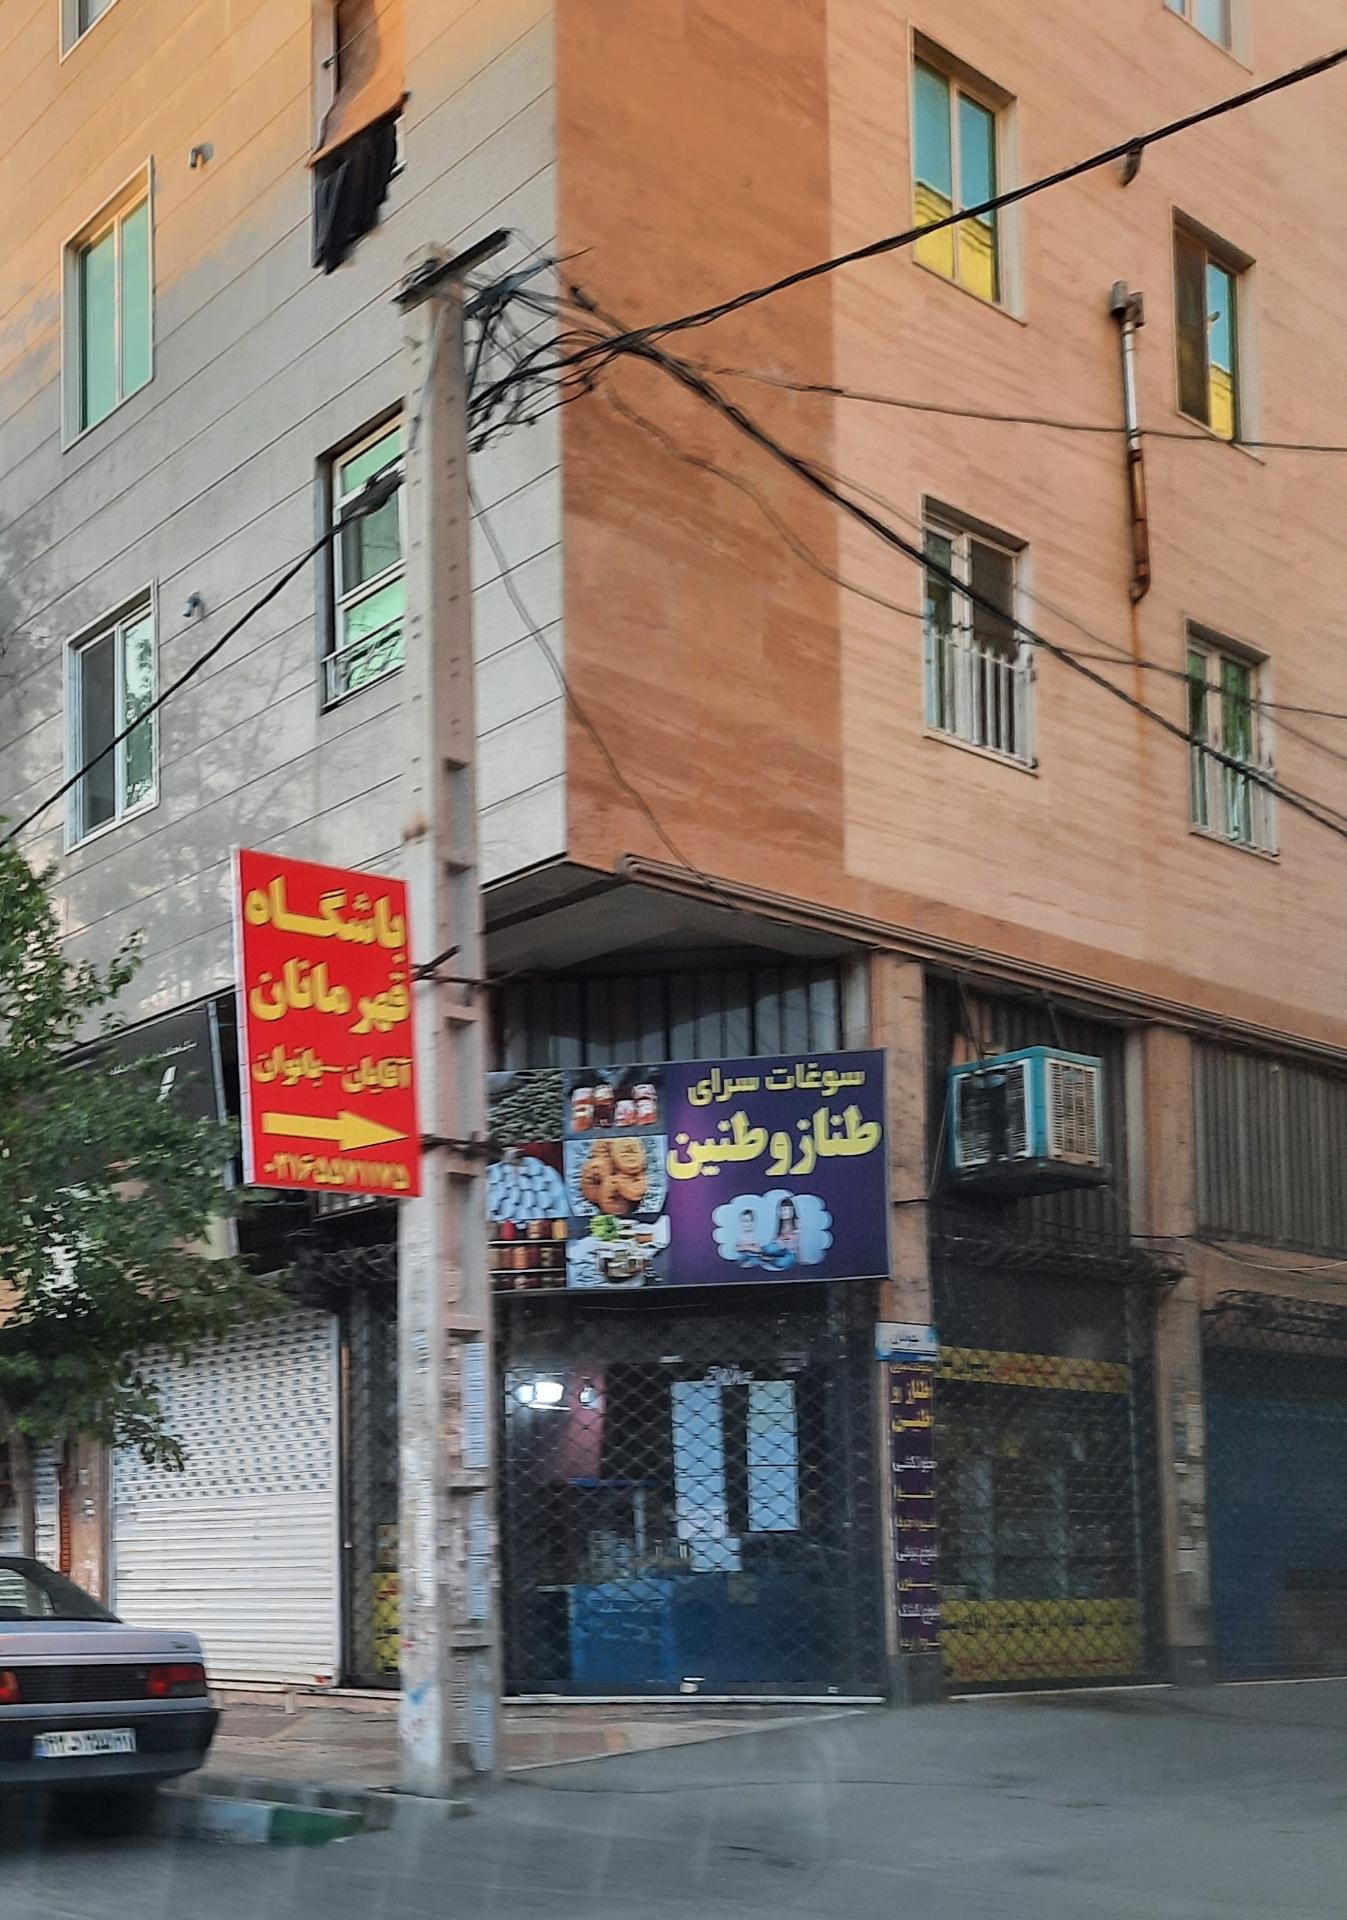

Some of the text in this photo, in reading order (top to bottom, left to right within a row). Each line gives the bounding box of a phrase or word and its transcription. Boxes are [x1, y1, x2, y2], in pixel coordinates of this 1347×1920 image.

[244, 874, 406, 965] باشگاه
[687, 1062, 866, 1106] سوغات سرای
[666, 1104, 883, 1180] طناز و طنین
